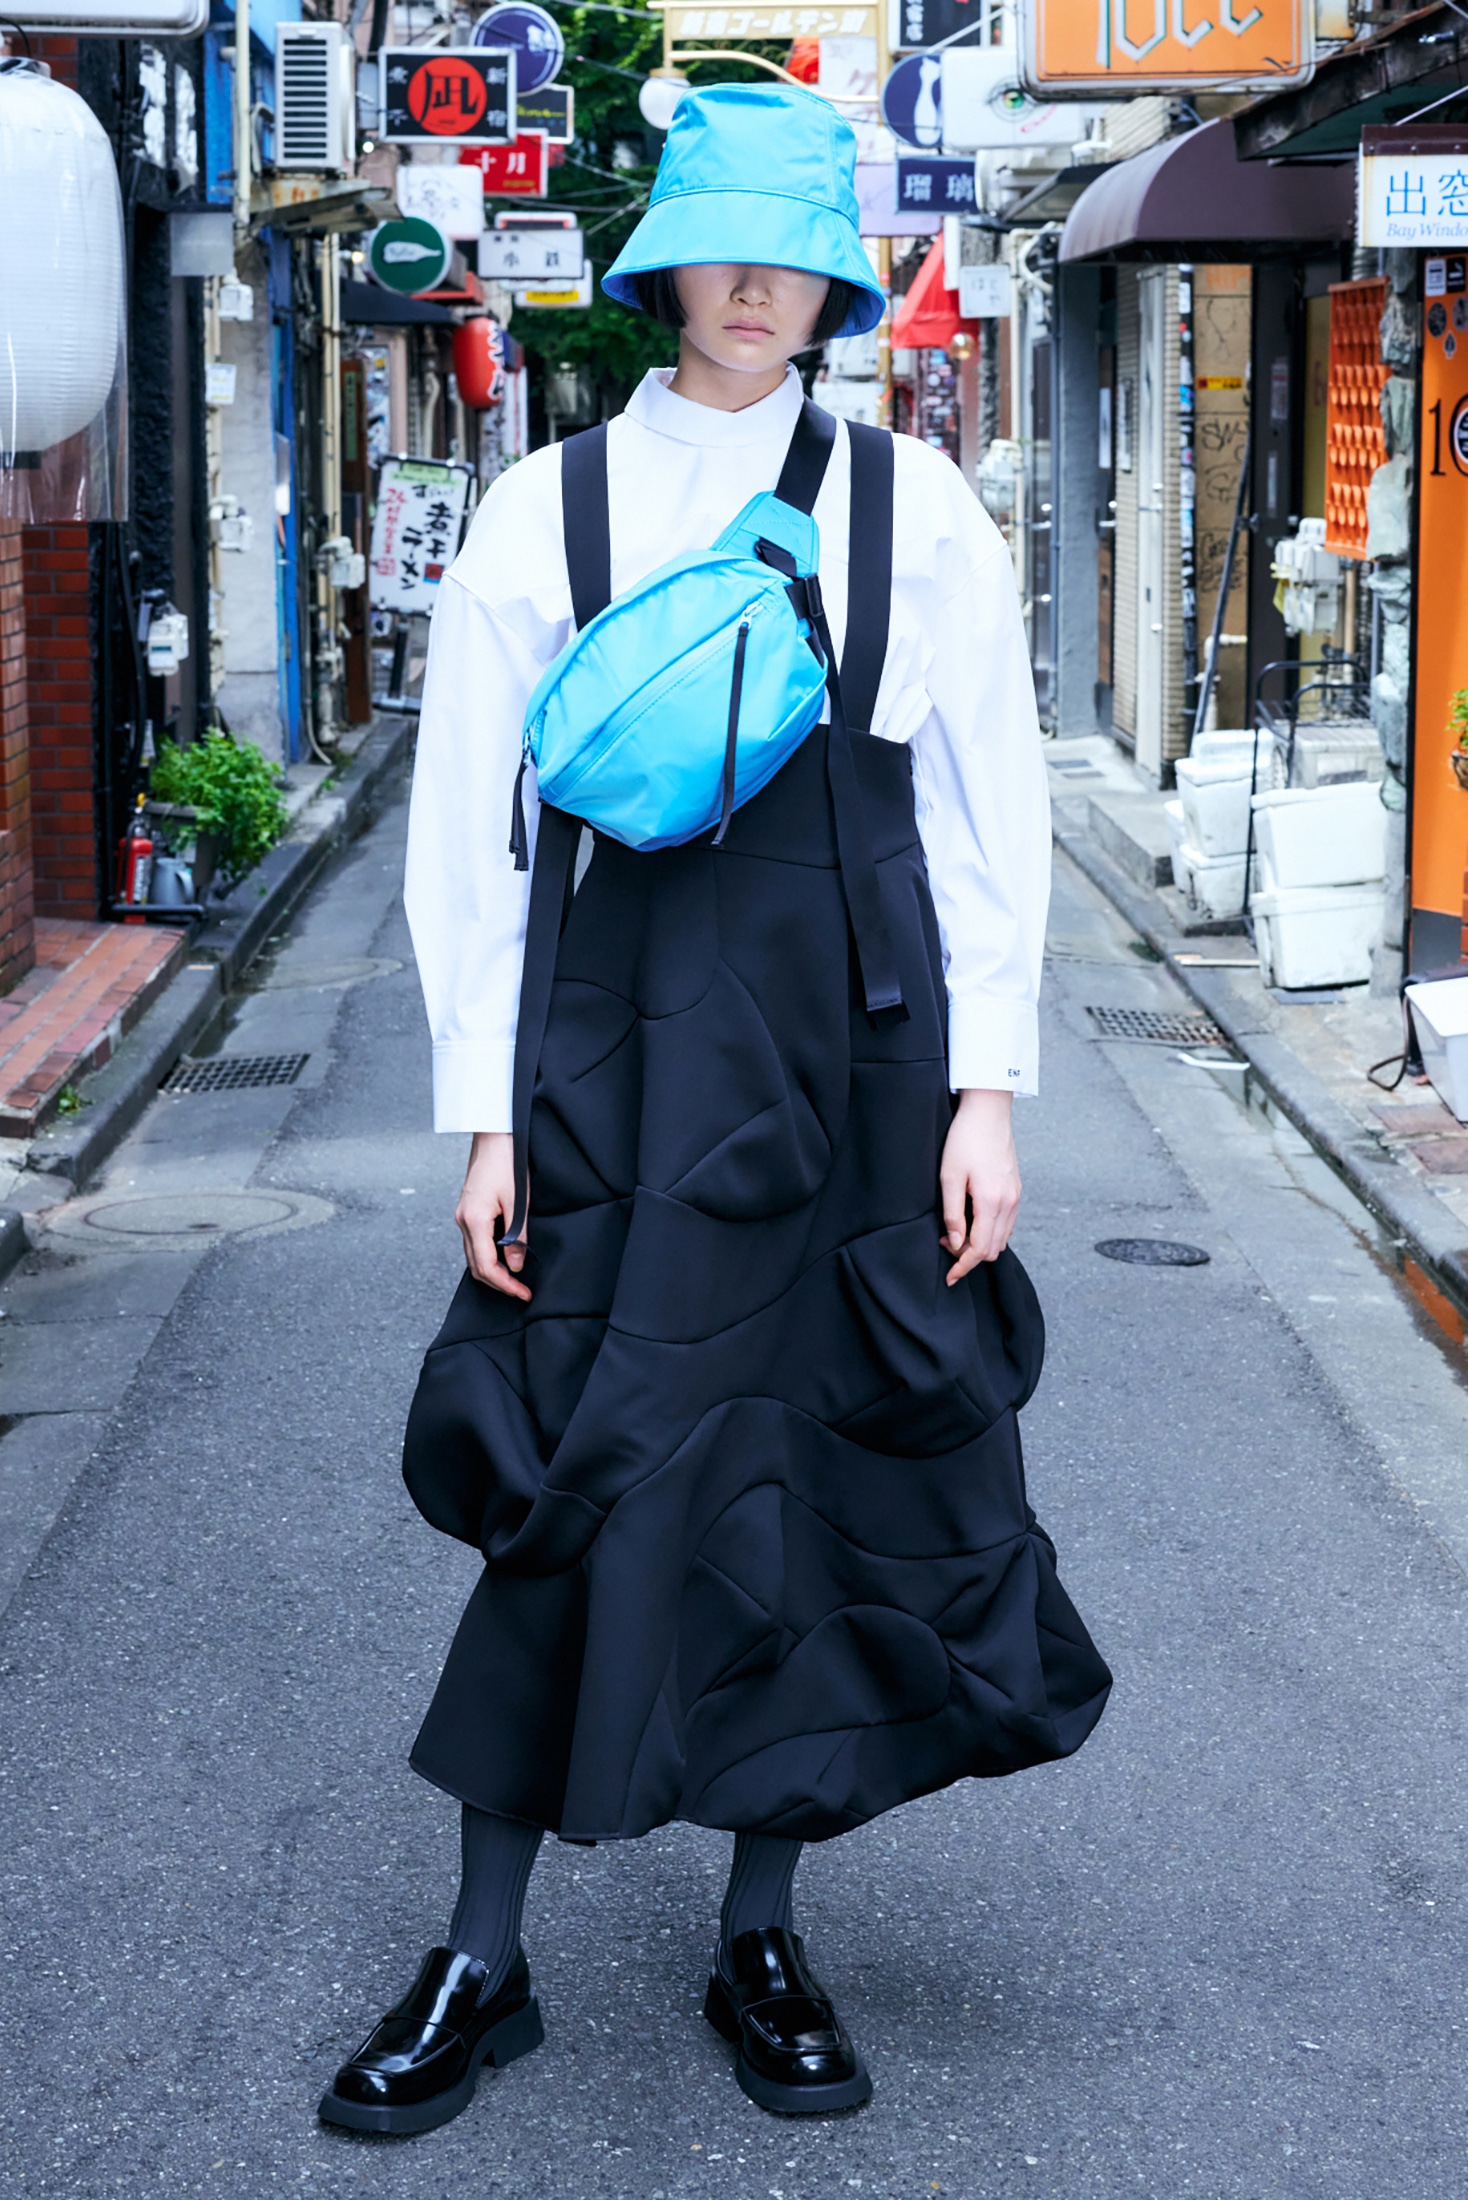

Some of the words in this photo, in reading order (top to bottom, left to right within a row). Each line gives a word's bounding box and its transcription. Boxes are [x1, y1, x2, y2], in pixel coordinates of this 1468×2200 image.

[1387, 222, 1416, 240] Bay
[401, 526, 424, 590] ラーメン
